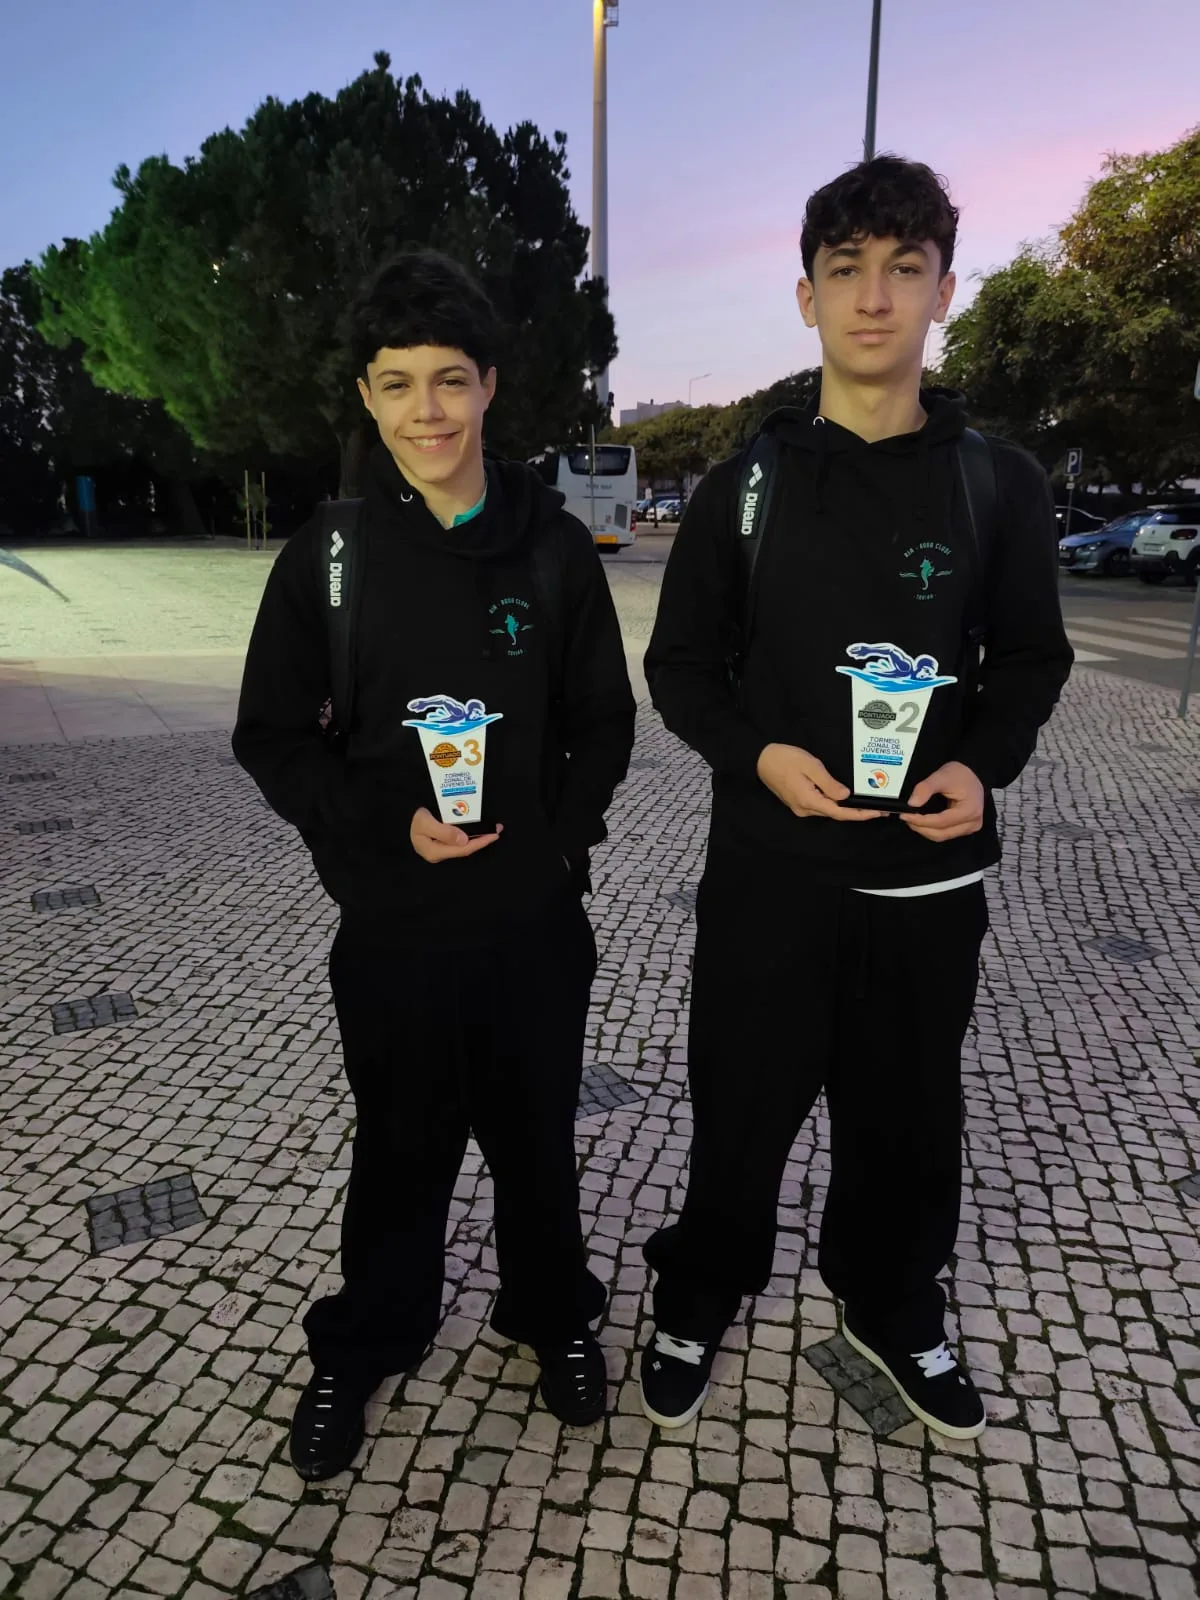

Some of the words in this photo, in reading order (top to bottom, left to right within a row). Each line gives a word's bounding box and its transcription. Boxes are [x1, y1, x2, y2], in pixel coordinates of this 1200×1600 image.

[1067, 451, 1078, 473] P
[741, 492, 758, 535] arena
[935, 543, 952, 556] CLUBE
[329, 562, 343, 607] arena
[895, 701, 920, 733] 2
[464, 738, 482, 766] 3
[869, 736, 900, 744] TORNEIO
